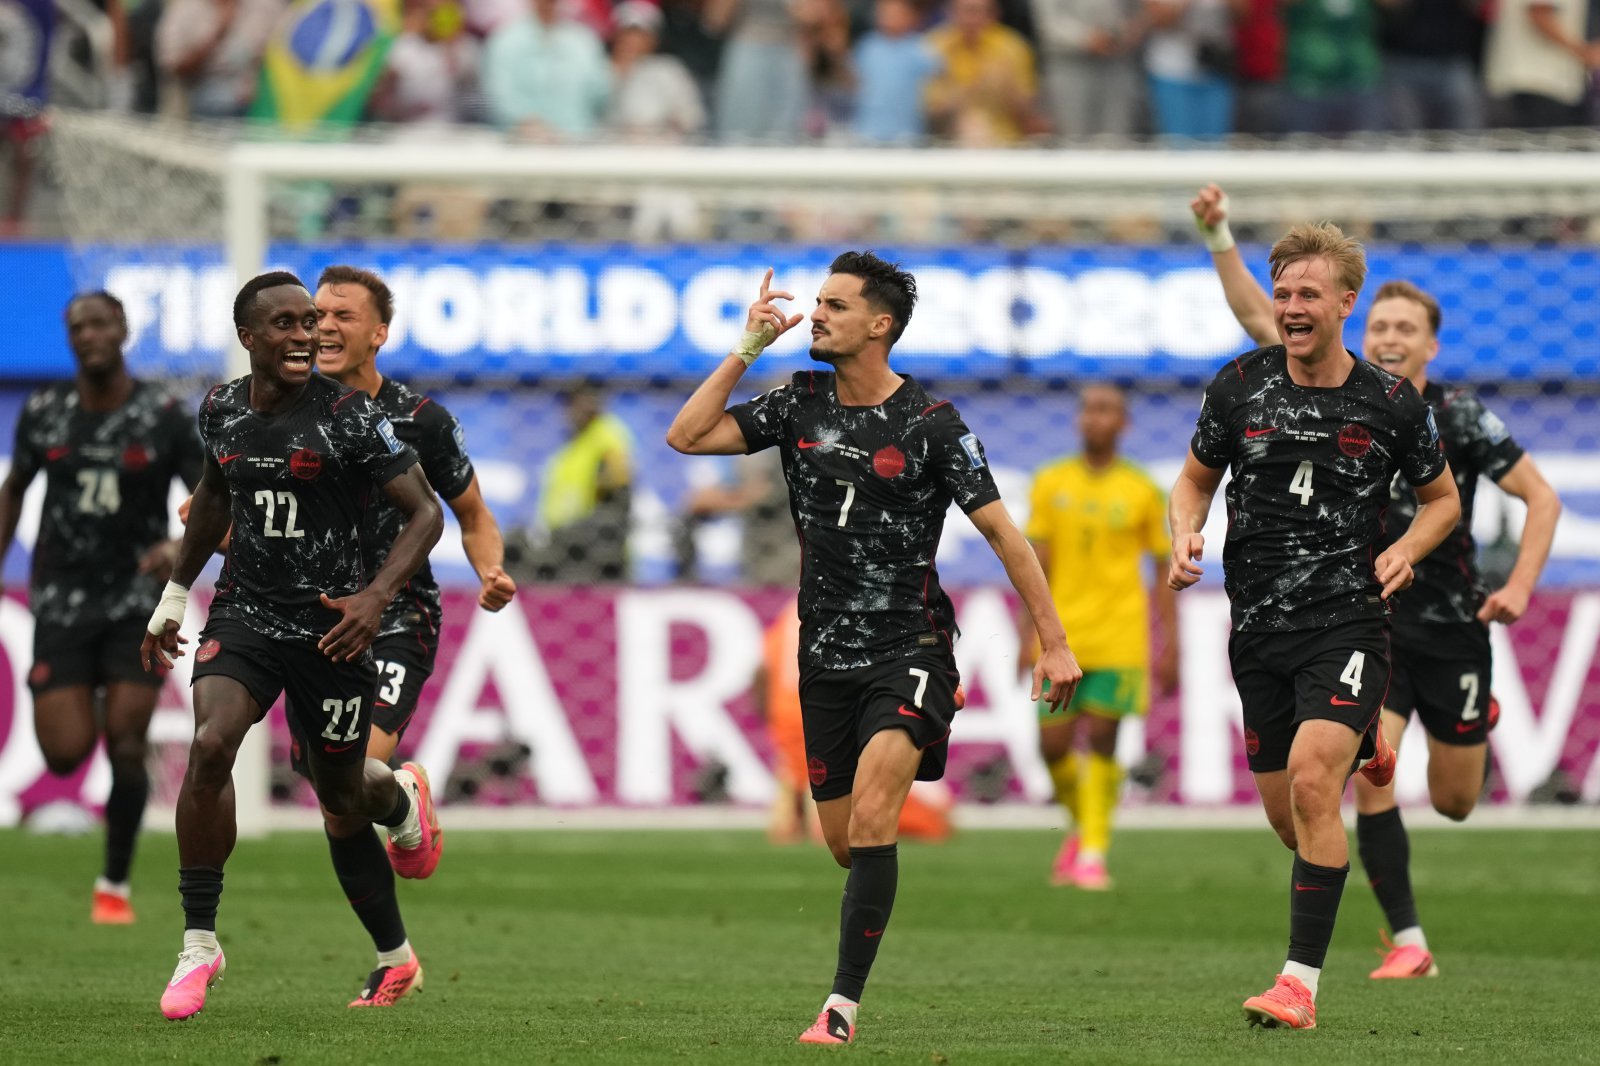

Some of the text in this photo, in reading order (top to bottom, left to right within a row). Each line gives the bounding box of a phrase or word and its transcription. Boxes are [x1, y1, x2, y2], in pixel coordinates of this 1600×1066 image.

[370, 265, 678, 356] ORLD
[1341, 437, 1369, 445] CANADA
[77, 468, 121, 514] 24
[835, 479, 856, 527] 7
[1288, 460, 1314, 506] 4
[254, 489, 305, 538] 22
[375, 660, 407, 705] 3
[909, 667, 930, 709] 7
[1339, 650, 1366, 698] 4
[1459, 673, 1480, 721] 2
[320, 695, 362, 742] 22
